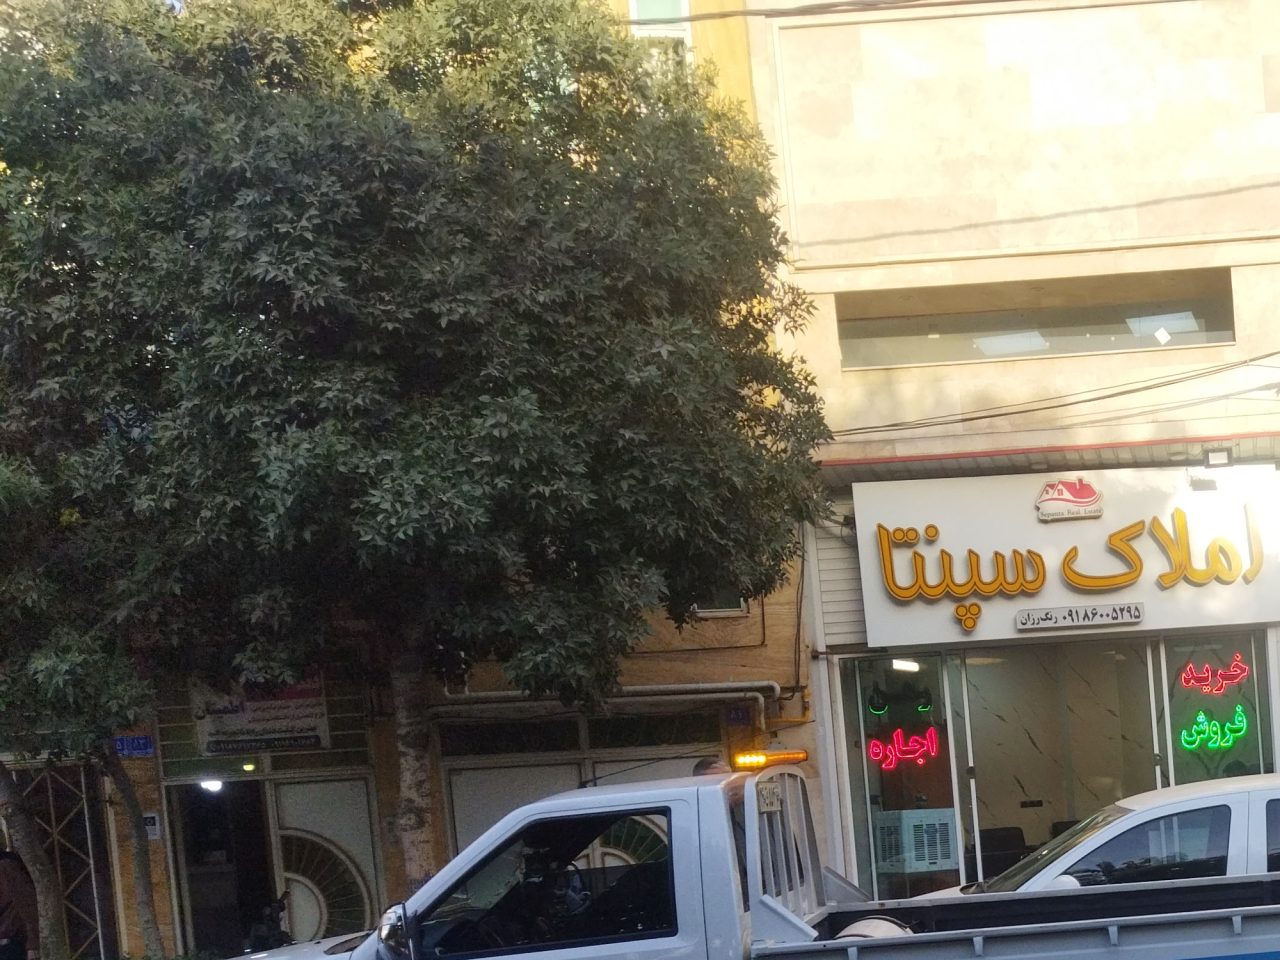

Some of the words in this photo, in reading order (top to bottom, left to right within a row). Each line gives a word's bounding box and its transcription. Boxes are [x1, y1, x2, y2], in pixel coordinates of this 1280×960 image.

[1062, 504, 1264, 590] املاک
[877, 522, 1047, 632] سپنتا
[1181, 652, 1249, 694] خرید
[869, 726, 937, 769] اجاره
[1181, 704, 1247, 748] فروش
